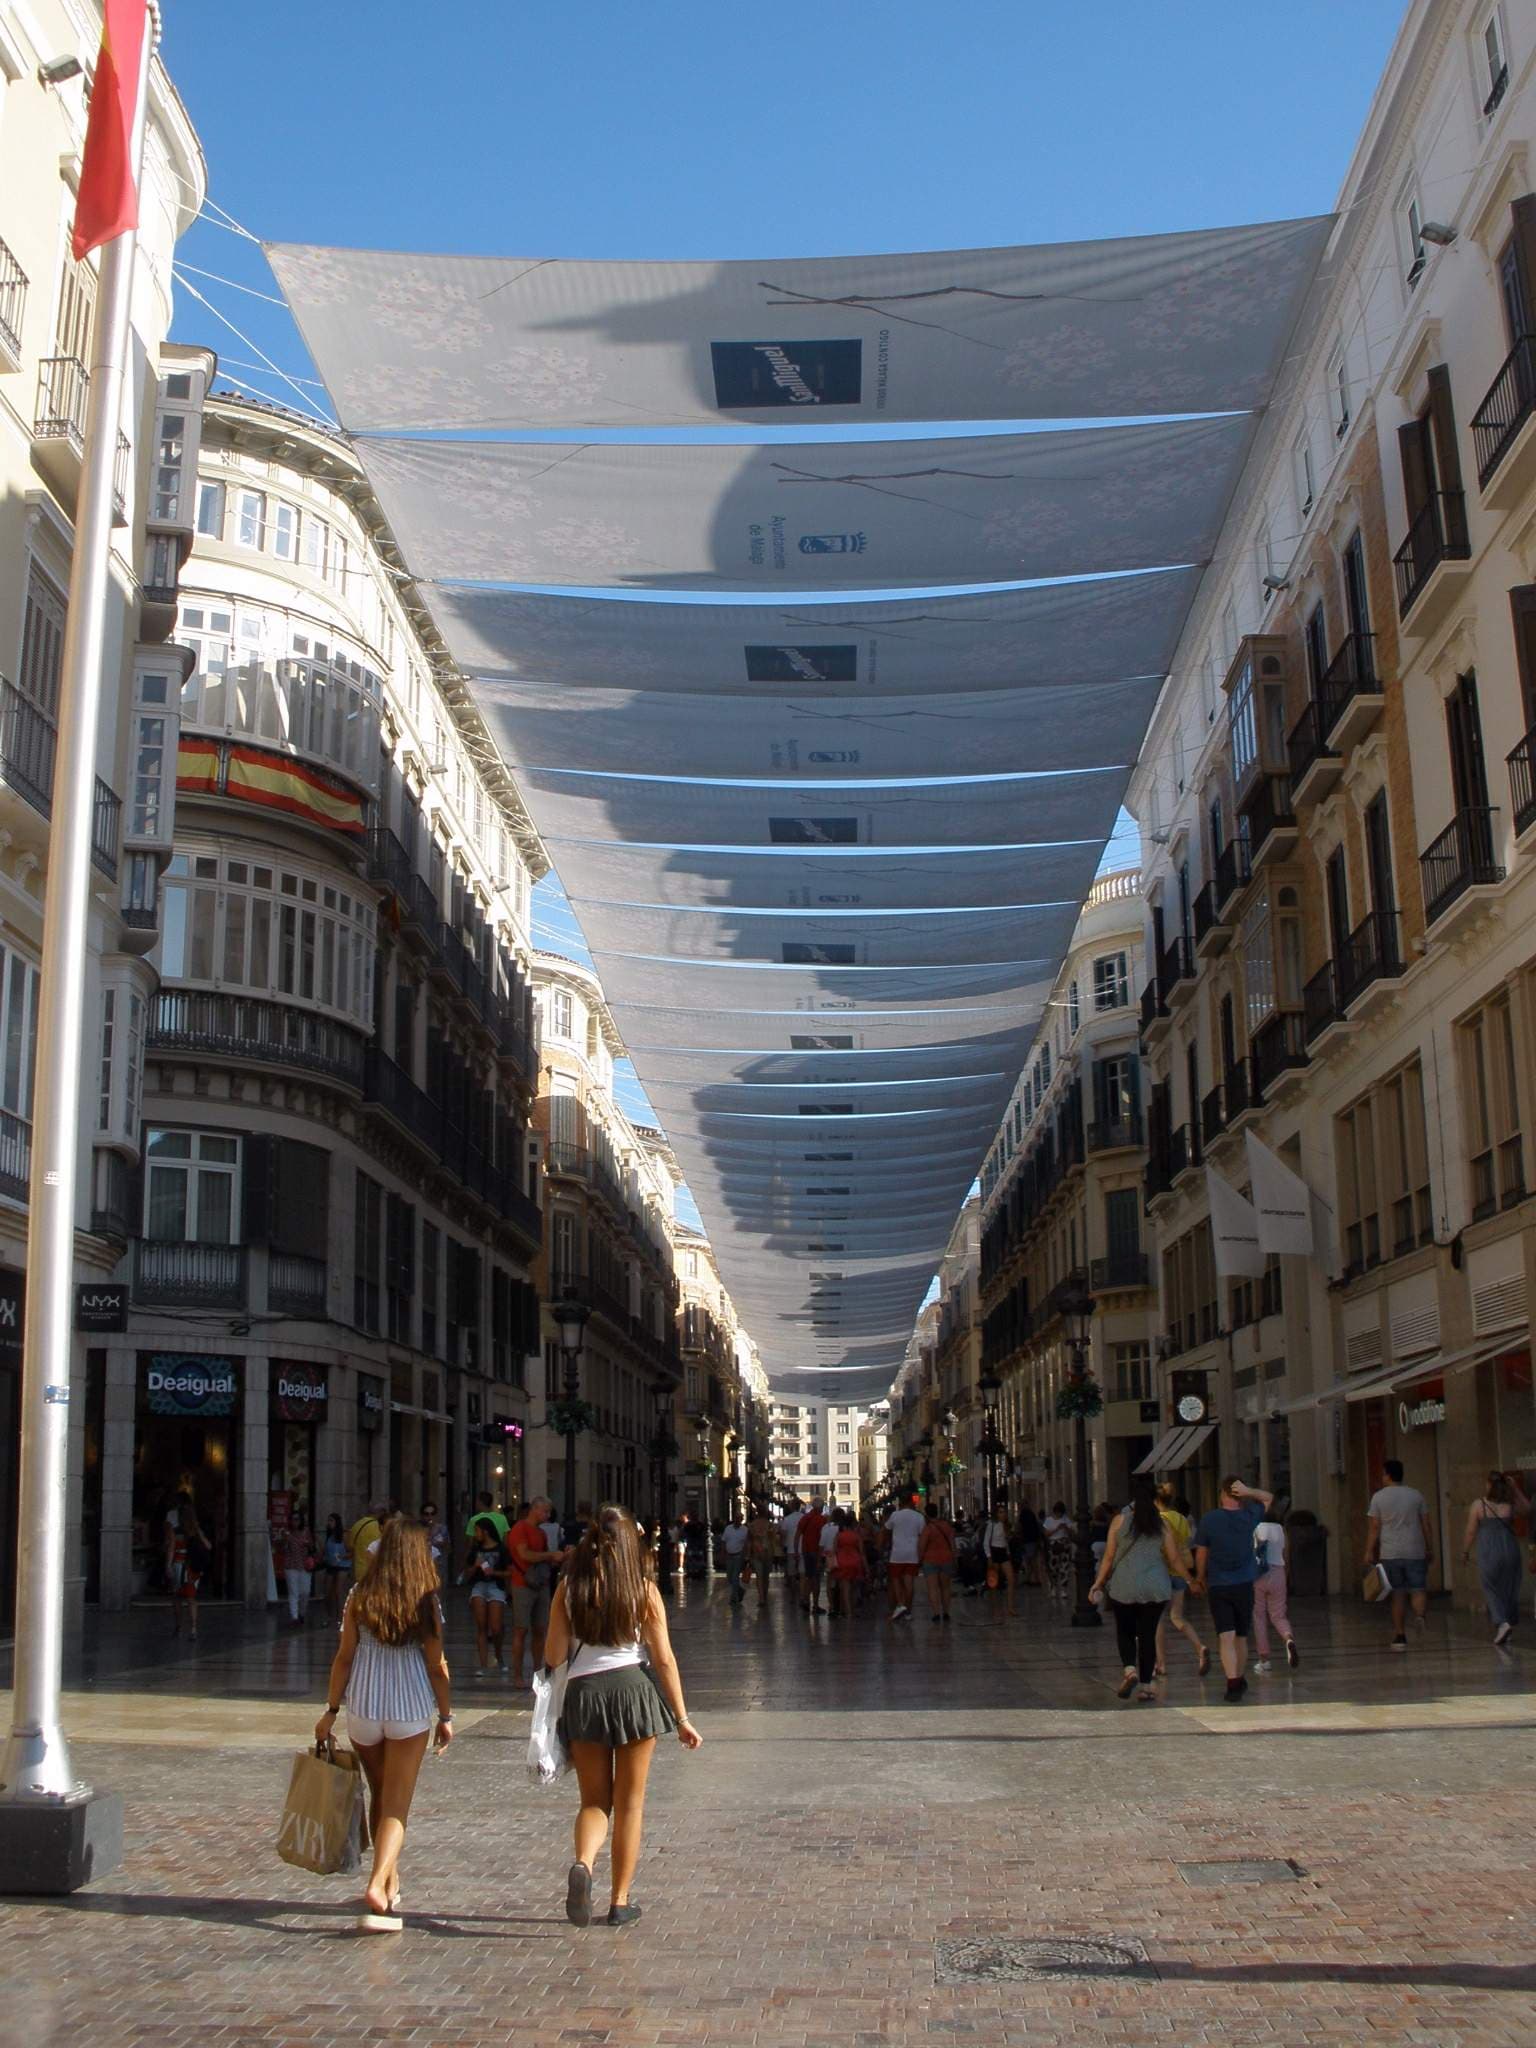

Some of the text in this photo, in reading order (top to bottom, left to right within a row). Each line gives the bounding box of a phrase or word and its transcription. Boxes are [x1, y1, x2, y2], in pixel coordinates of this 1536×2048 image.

[878, 329, 889, 362] CONTIGO
[82, 1295, 120, 1307] NYX
[148, 1373, 233, 1395] Desigual
[278, 1378, 326, 1401] Desigual
[1409, 1399, 1446, 1427] vodafone
